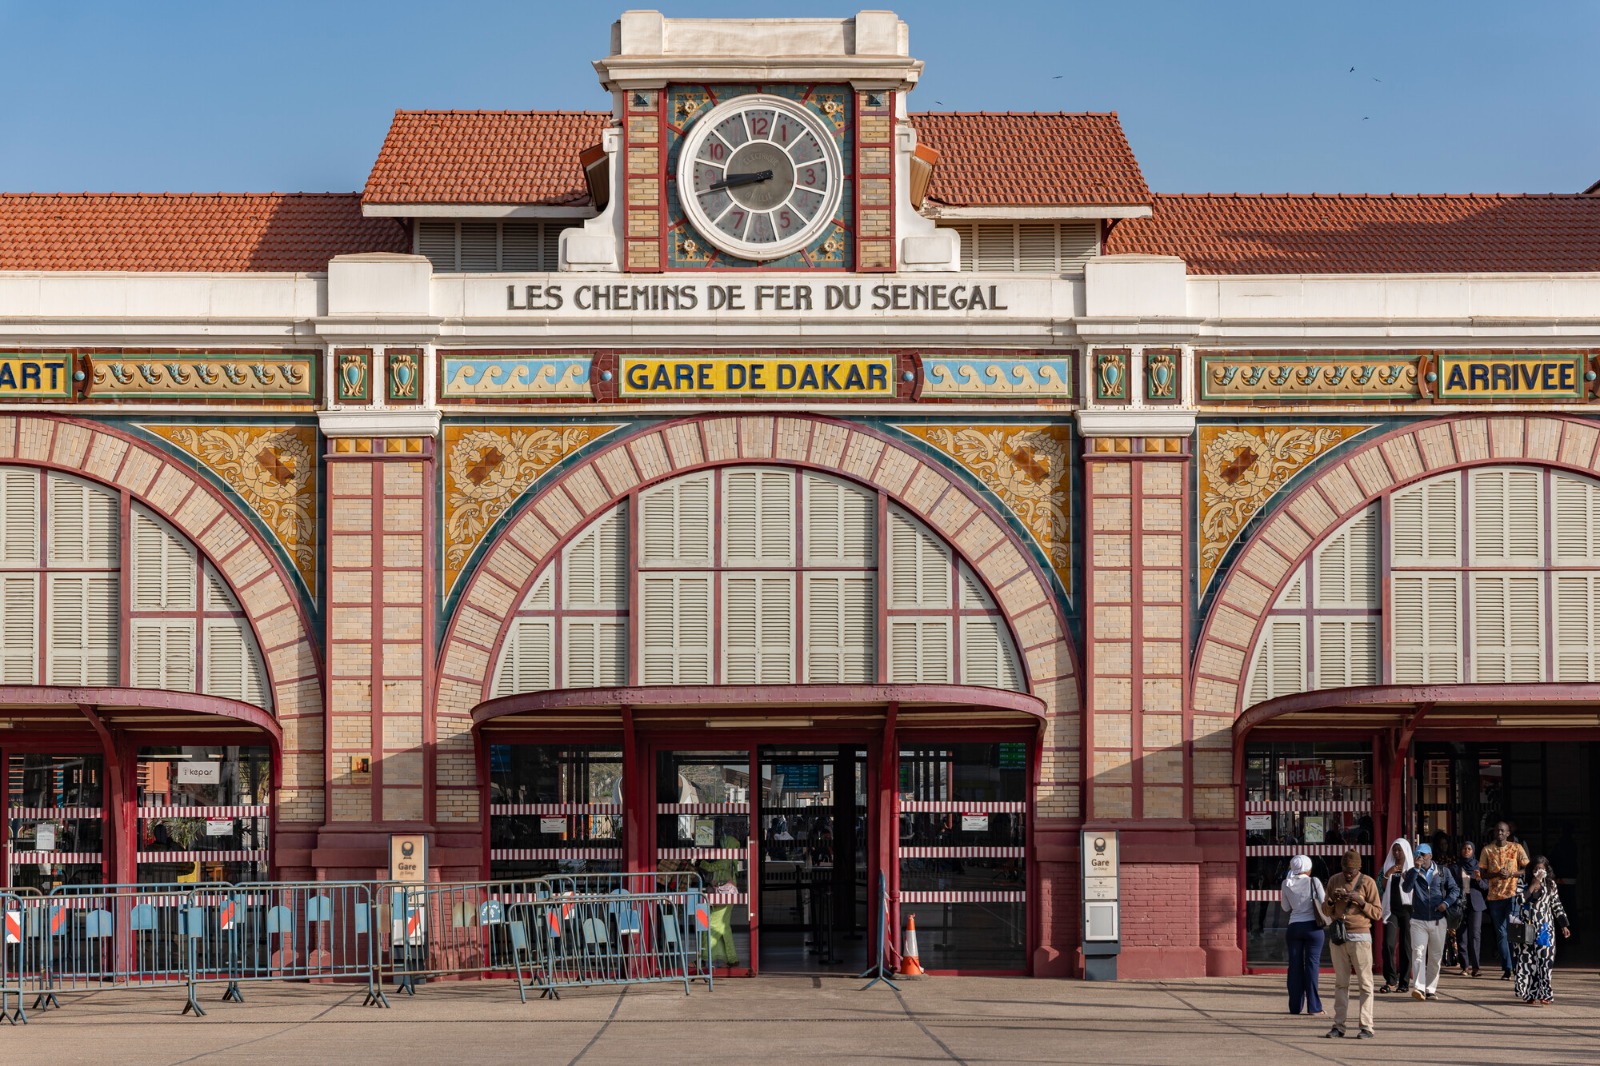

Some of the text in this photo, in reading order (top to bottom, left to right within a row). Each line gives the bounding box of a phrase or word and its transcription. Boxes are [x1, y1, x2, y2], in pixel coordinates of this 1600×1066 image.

[752, 118, 768, 135] 12
[781, 125, 787, 142] 1
[709, 143, 724, 160] 10
[704, 169, 716, 186] 9
[805, 168, 816, 185] 3
[732, 211, 745, 229] 7
[780, 211, 790, 229] 5
[506, 285, 1008, 310] LES CHEMINS DE FER DU SENEGAL
[627, 364, 887, 389] GARE DE DAKAR
[1446, 363, 1575, 390] ARRIVEE
[1289, 768, 1320, 783] RELAY
[398, 862, 417, 870] Gare
